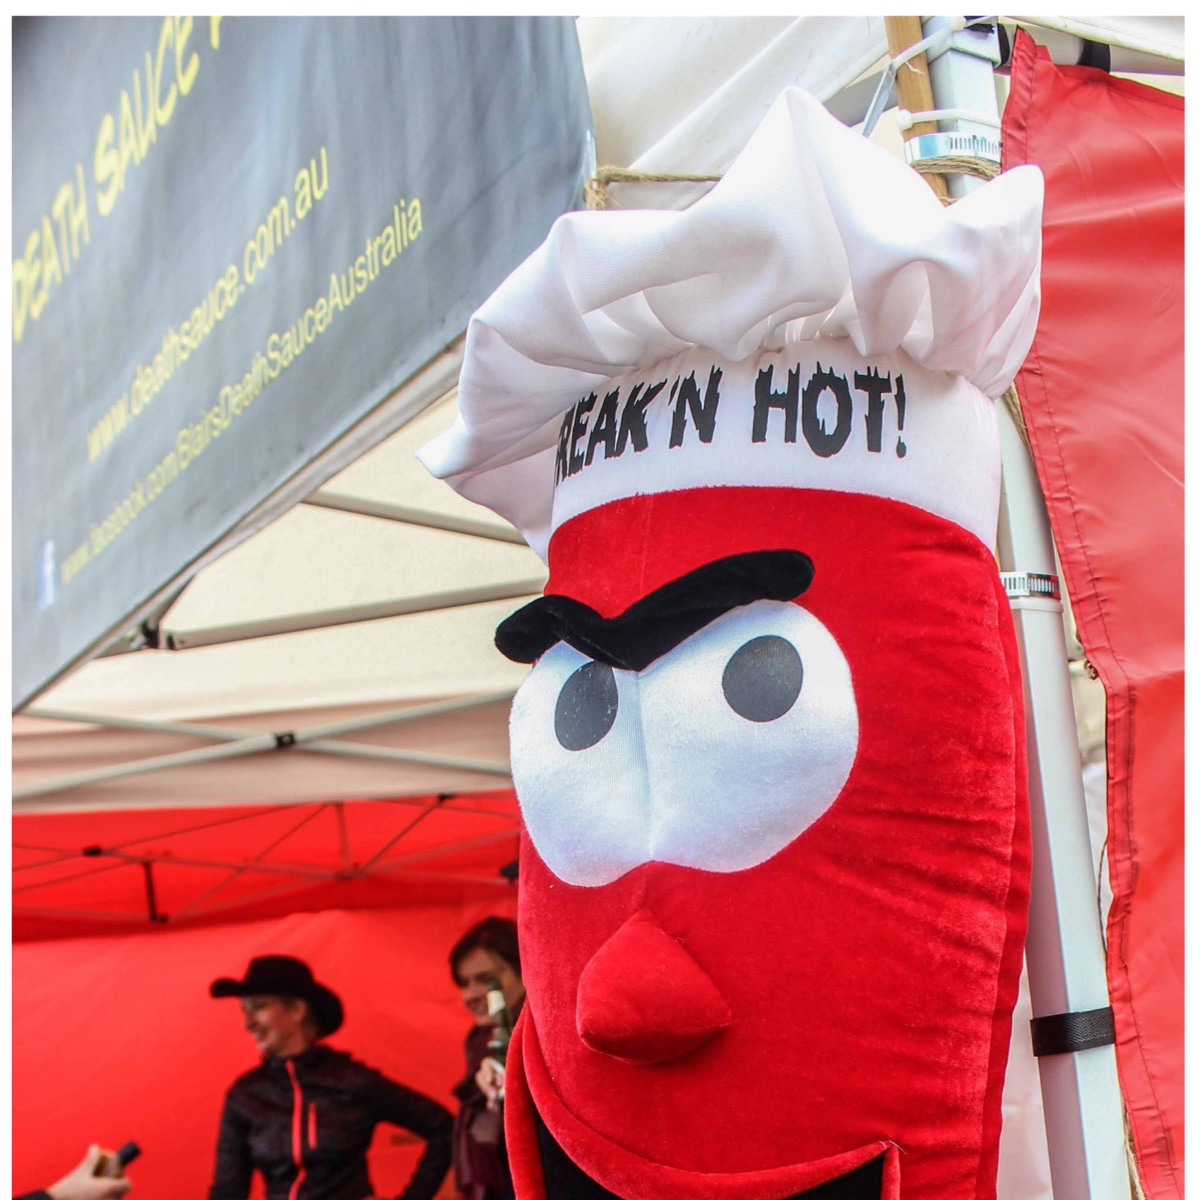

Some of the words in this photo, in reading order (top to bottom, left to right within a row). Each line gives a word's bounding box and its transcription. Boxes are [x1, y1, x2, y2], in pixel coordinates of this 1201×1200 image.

[12, 162, 90, 343] DEATH
[94, 16, 200, 217] SAUCE
[87, 146, 329, 464] www.deathsauce.com.au
[751, 361, 907, 459] HOT!
